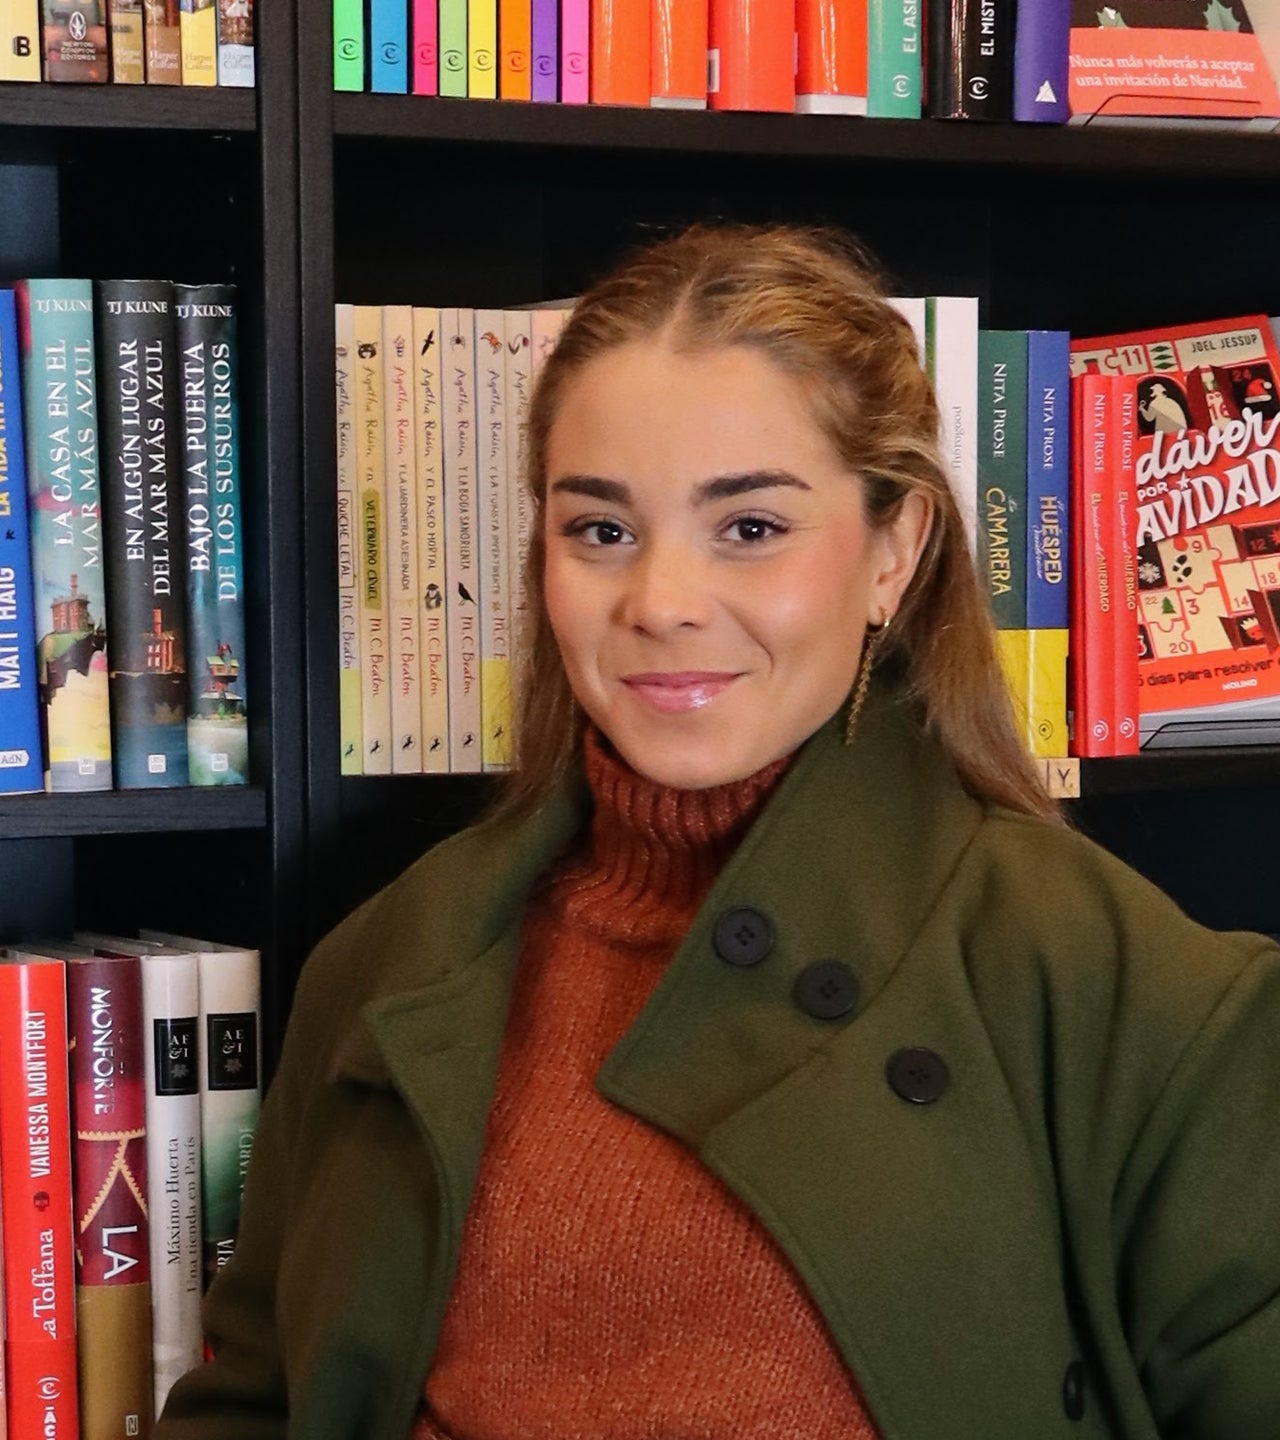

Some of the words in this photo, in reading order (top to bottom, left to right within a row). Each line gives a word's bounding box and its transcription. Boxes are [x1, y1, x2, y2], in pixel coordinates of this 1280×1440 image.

[903, 28, 917, 53] EL
[1191, 339, 1216, 353] JOEL
[1221, 335, 1257, 349] JESSUP
[1122, 349, 1143, 366] 11
[25, 1011, 48, 1092] MONTFORT
[31, 1094, 49, 1180] VANESSA
